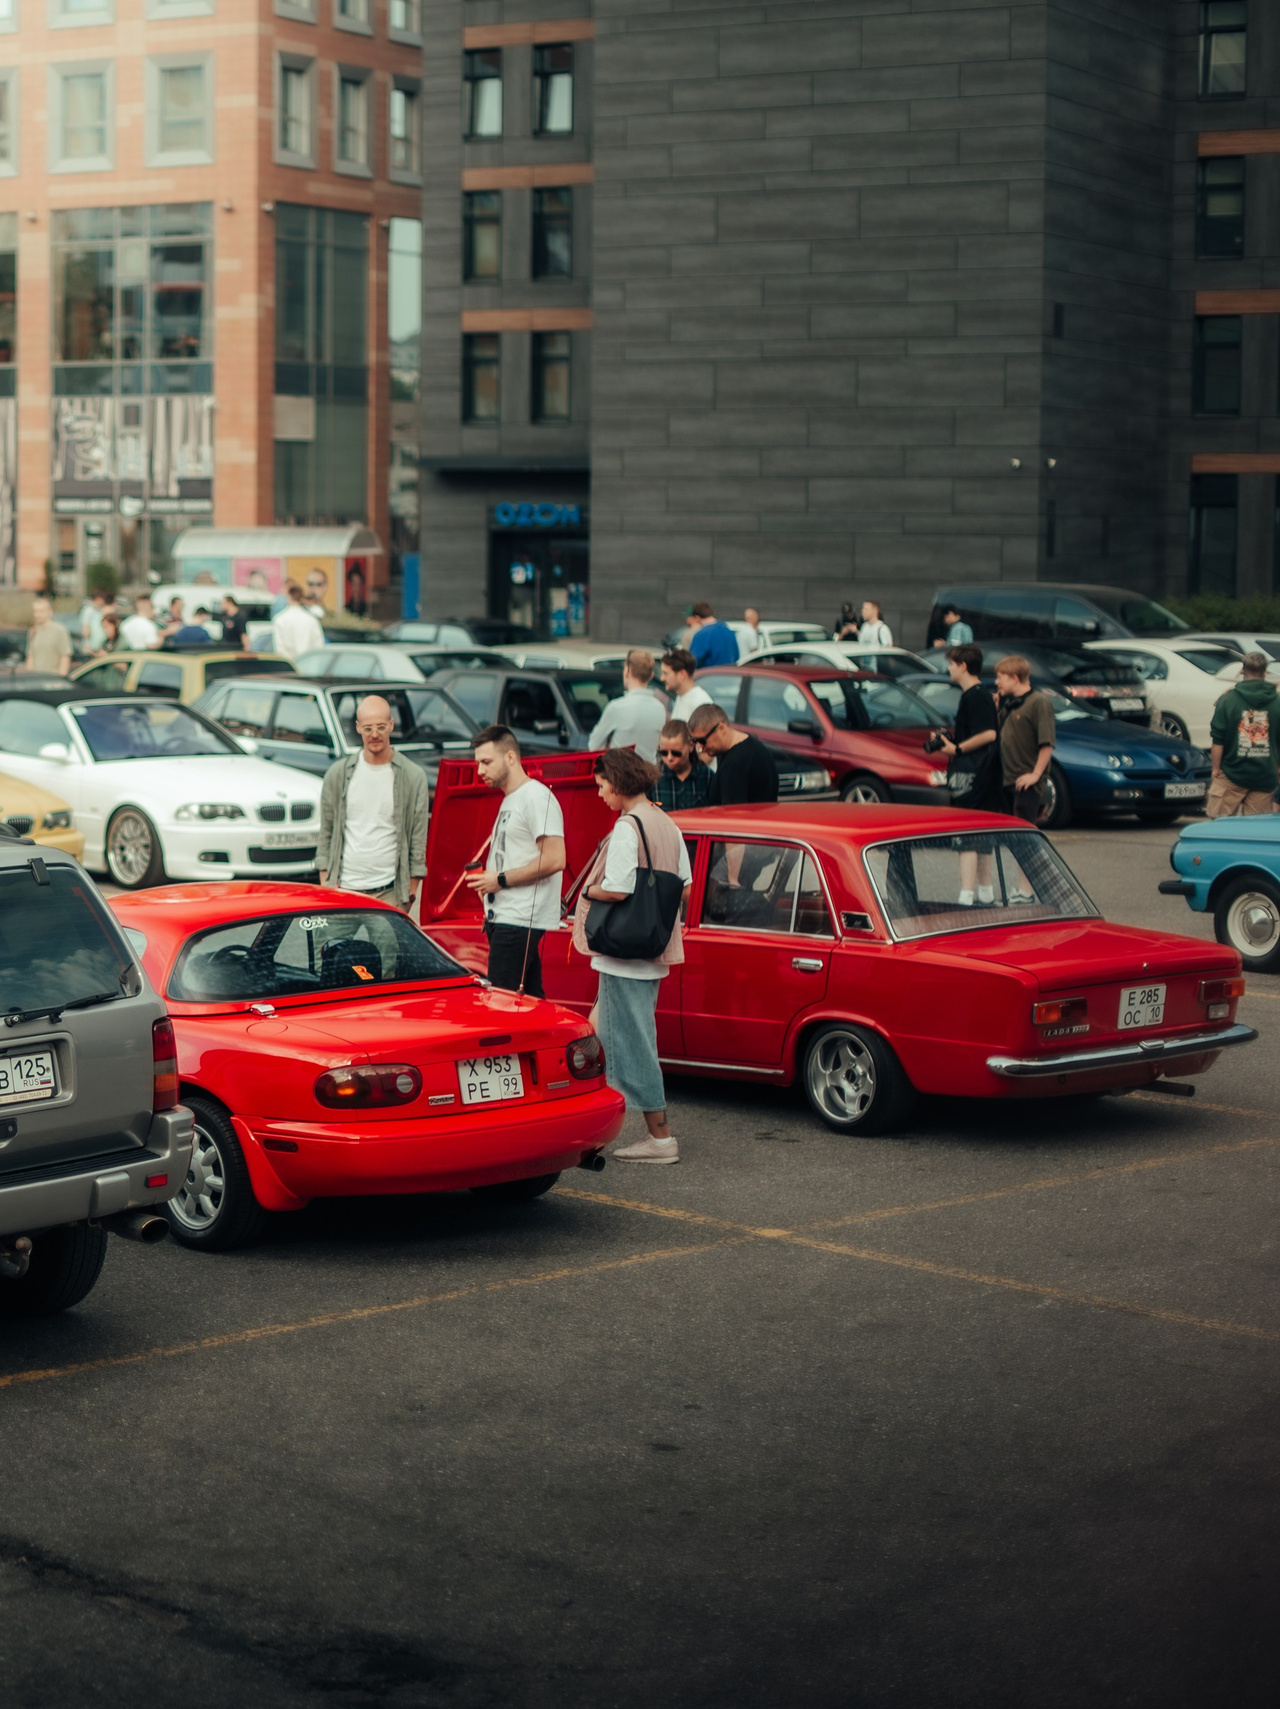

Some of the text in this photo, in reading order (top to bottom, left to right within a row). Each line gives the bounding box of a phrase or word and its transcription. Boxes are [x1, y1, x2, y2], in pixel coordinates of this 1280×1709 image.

[495, 502, 580, 527] OZON
[1140, 988, 1160, 1005] 285
[1124, 1006, 1160, 1025] ОС 10
[14, 1057, 46, 1079] 125
[484, 1055, 512, 1075] 953
[23, 1079, 40, 1087] RUS
[467, 1077, 518, 1100] РЕ 99
